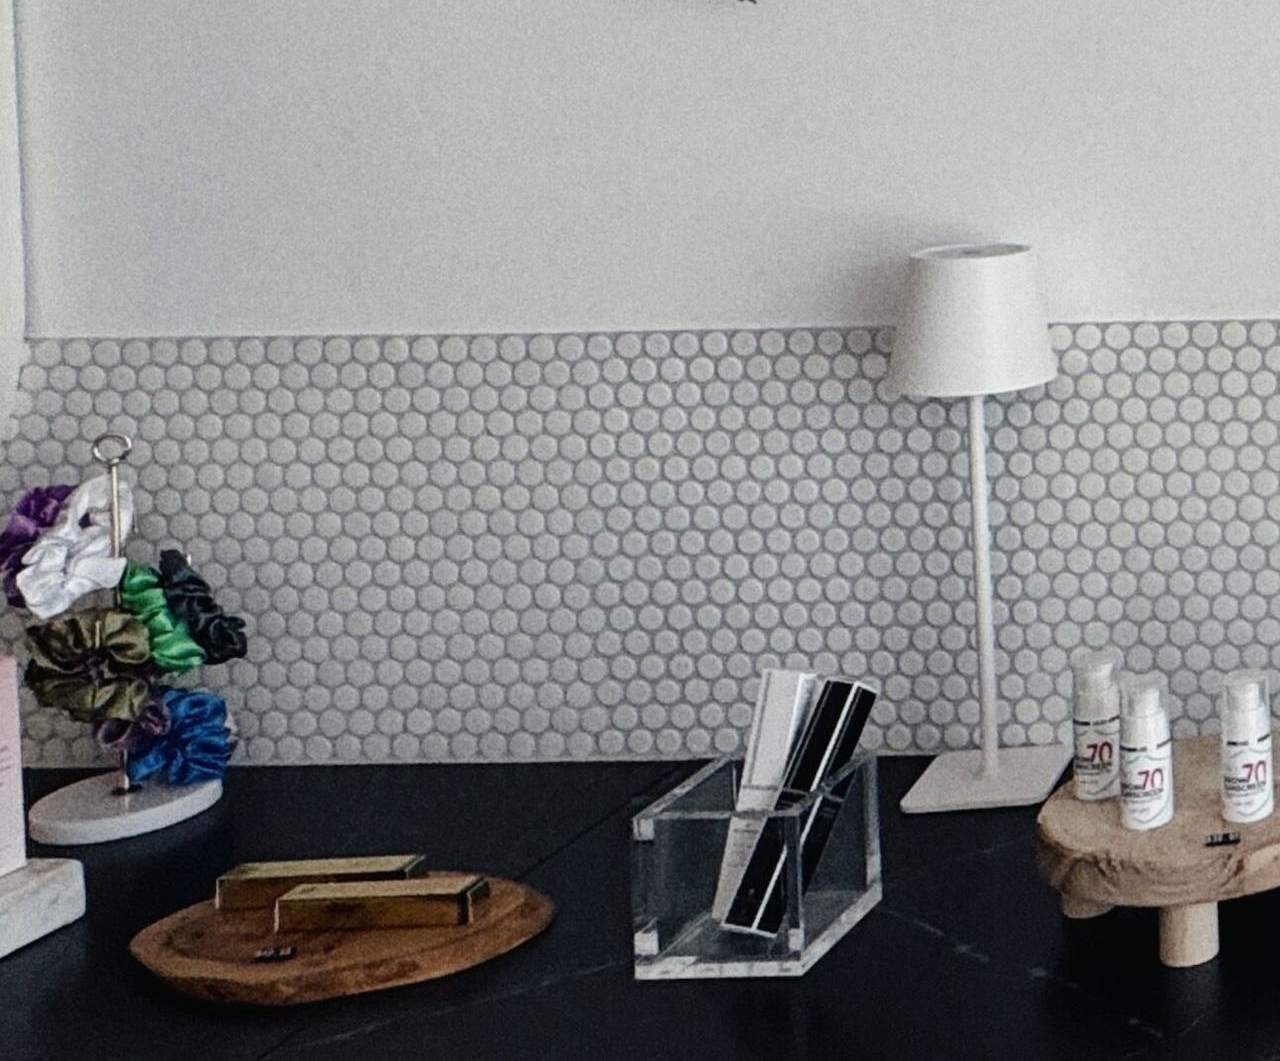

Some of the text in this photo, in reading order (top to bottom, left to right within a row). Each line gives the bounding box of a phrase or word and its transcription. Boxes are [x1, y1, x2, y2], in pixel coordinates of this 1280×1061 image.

[1086, 741, 1113, 763] 70
[1137, 768, 1164, 790] 70
[1242, 760, 1267, 783] 70
